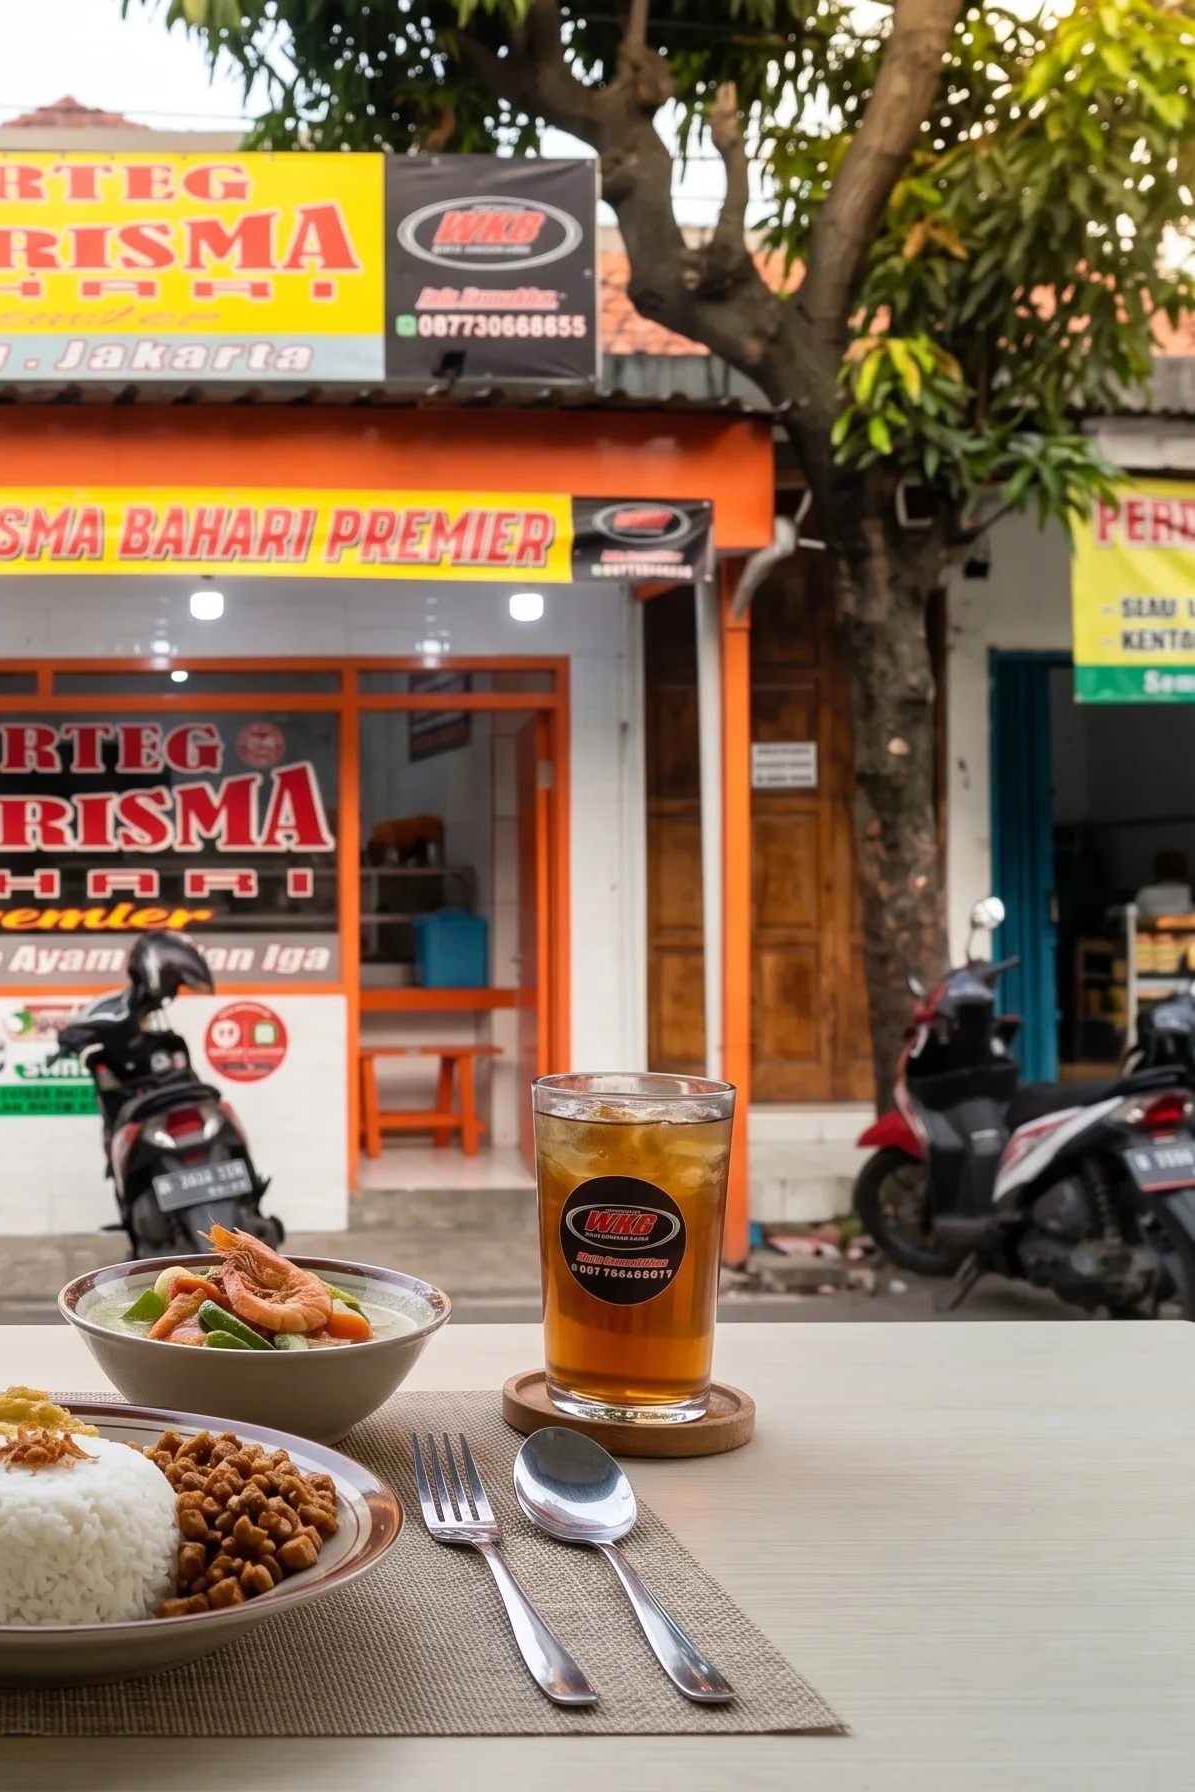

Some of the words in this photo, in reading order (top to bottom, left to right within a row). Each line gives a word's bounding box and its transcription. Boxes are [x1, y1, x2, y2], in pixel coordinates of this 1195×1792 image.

[432, 210, 546, 245] WKB
[55, 338, 314, 373] Jakarta
[116, 504, 317, 564] BAHARI
[323, 508, 556, 567] PREMIER
[7, 944, 125, 975] Ayam
[196, 944, 255, 972] an
[261, 942, 331, 975] Iga
